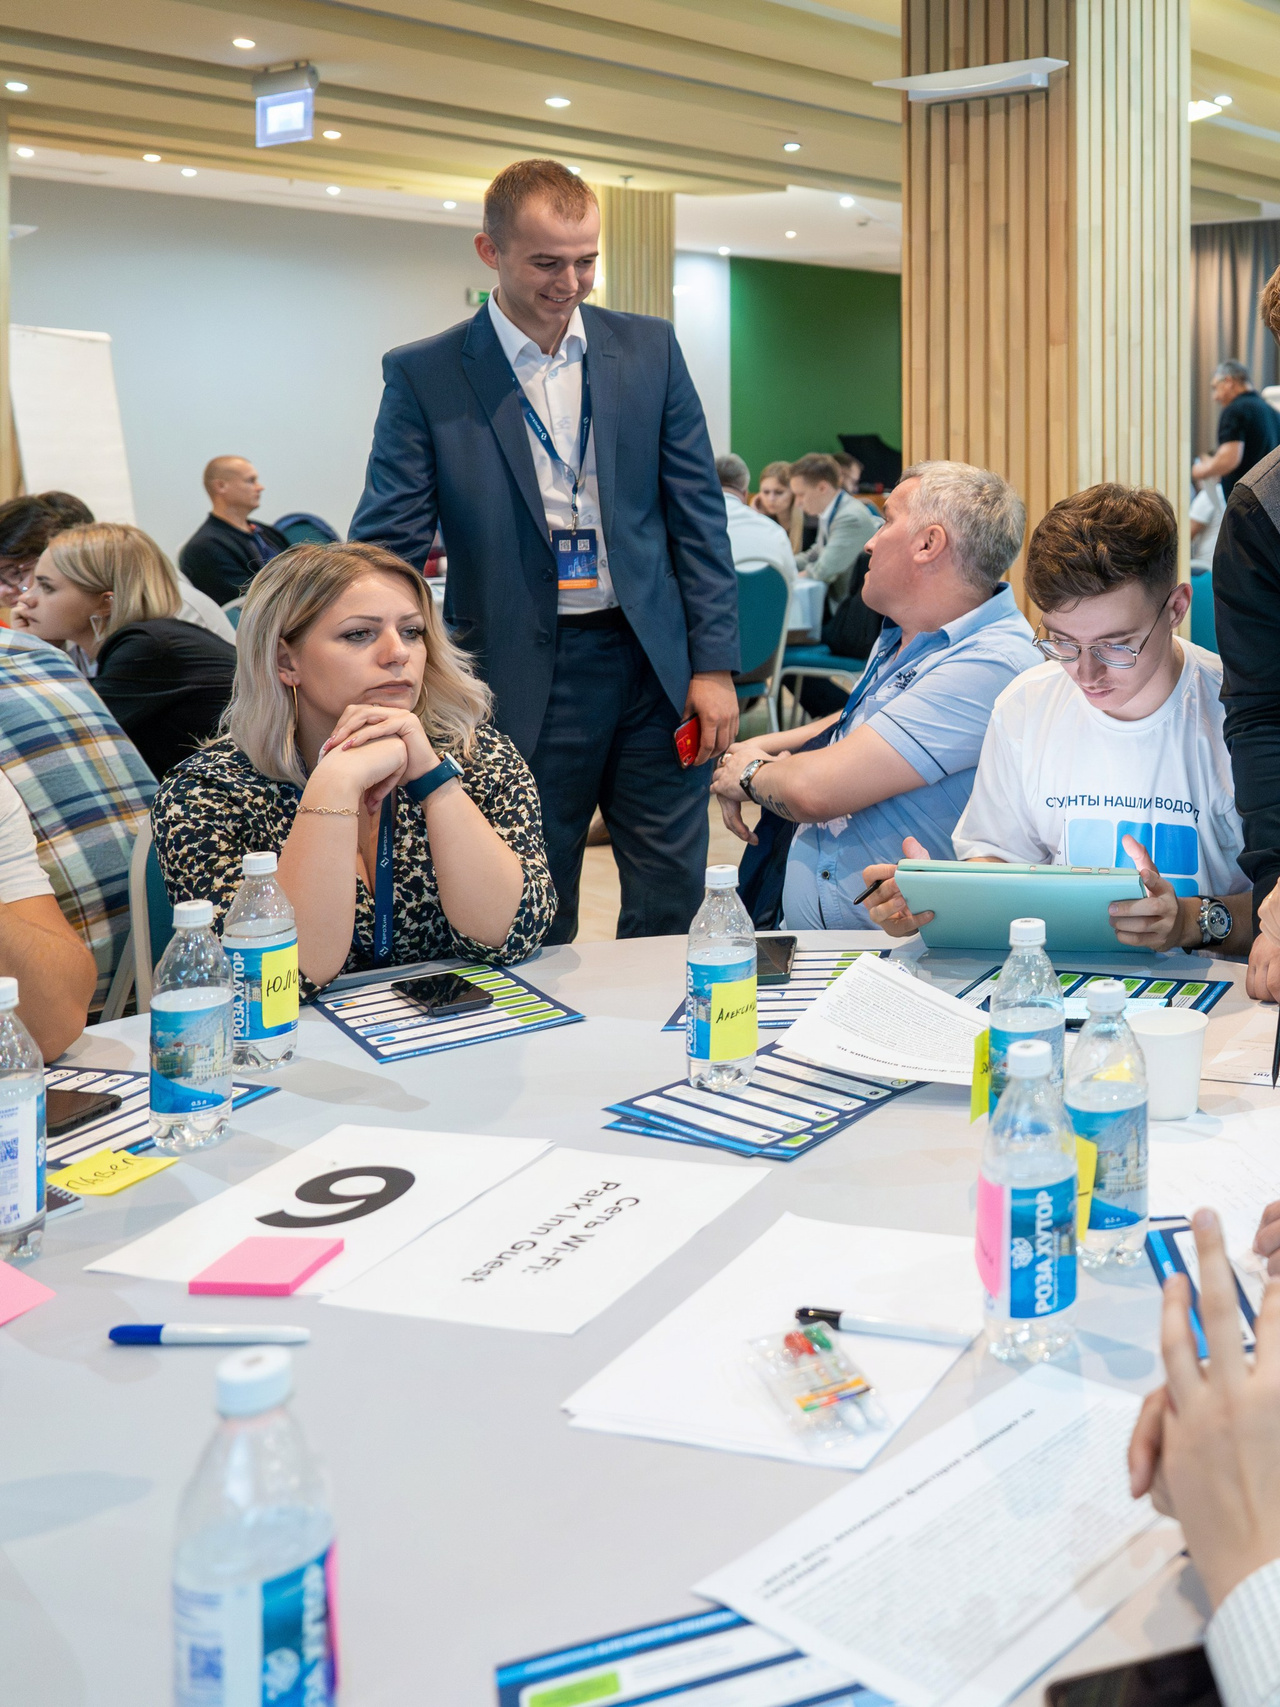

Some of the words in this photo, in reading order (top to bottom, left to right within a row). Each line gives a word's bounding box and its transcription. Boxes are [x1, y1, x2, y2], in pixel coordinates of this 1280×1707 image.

[1103, 795, 1153, 810] НАШЛИ
[232, 951, 246, 998] ХУТОР
[233, 1000, 246, 1038] РОЗА
[565, 1180, 623, 1211] Park
[583, 1196, 641, 1229] Сеть
[530, 1213, 577, 1237] Inn
[1035, 1190, 1054, 1258] ХУТОР
[461, 1239, 538, 1283] Guest
[521, 1233, 596, 1275] Wi-Fi:
[1034, 1257, 1054, 1315] РОЗА
